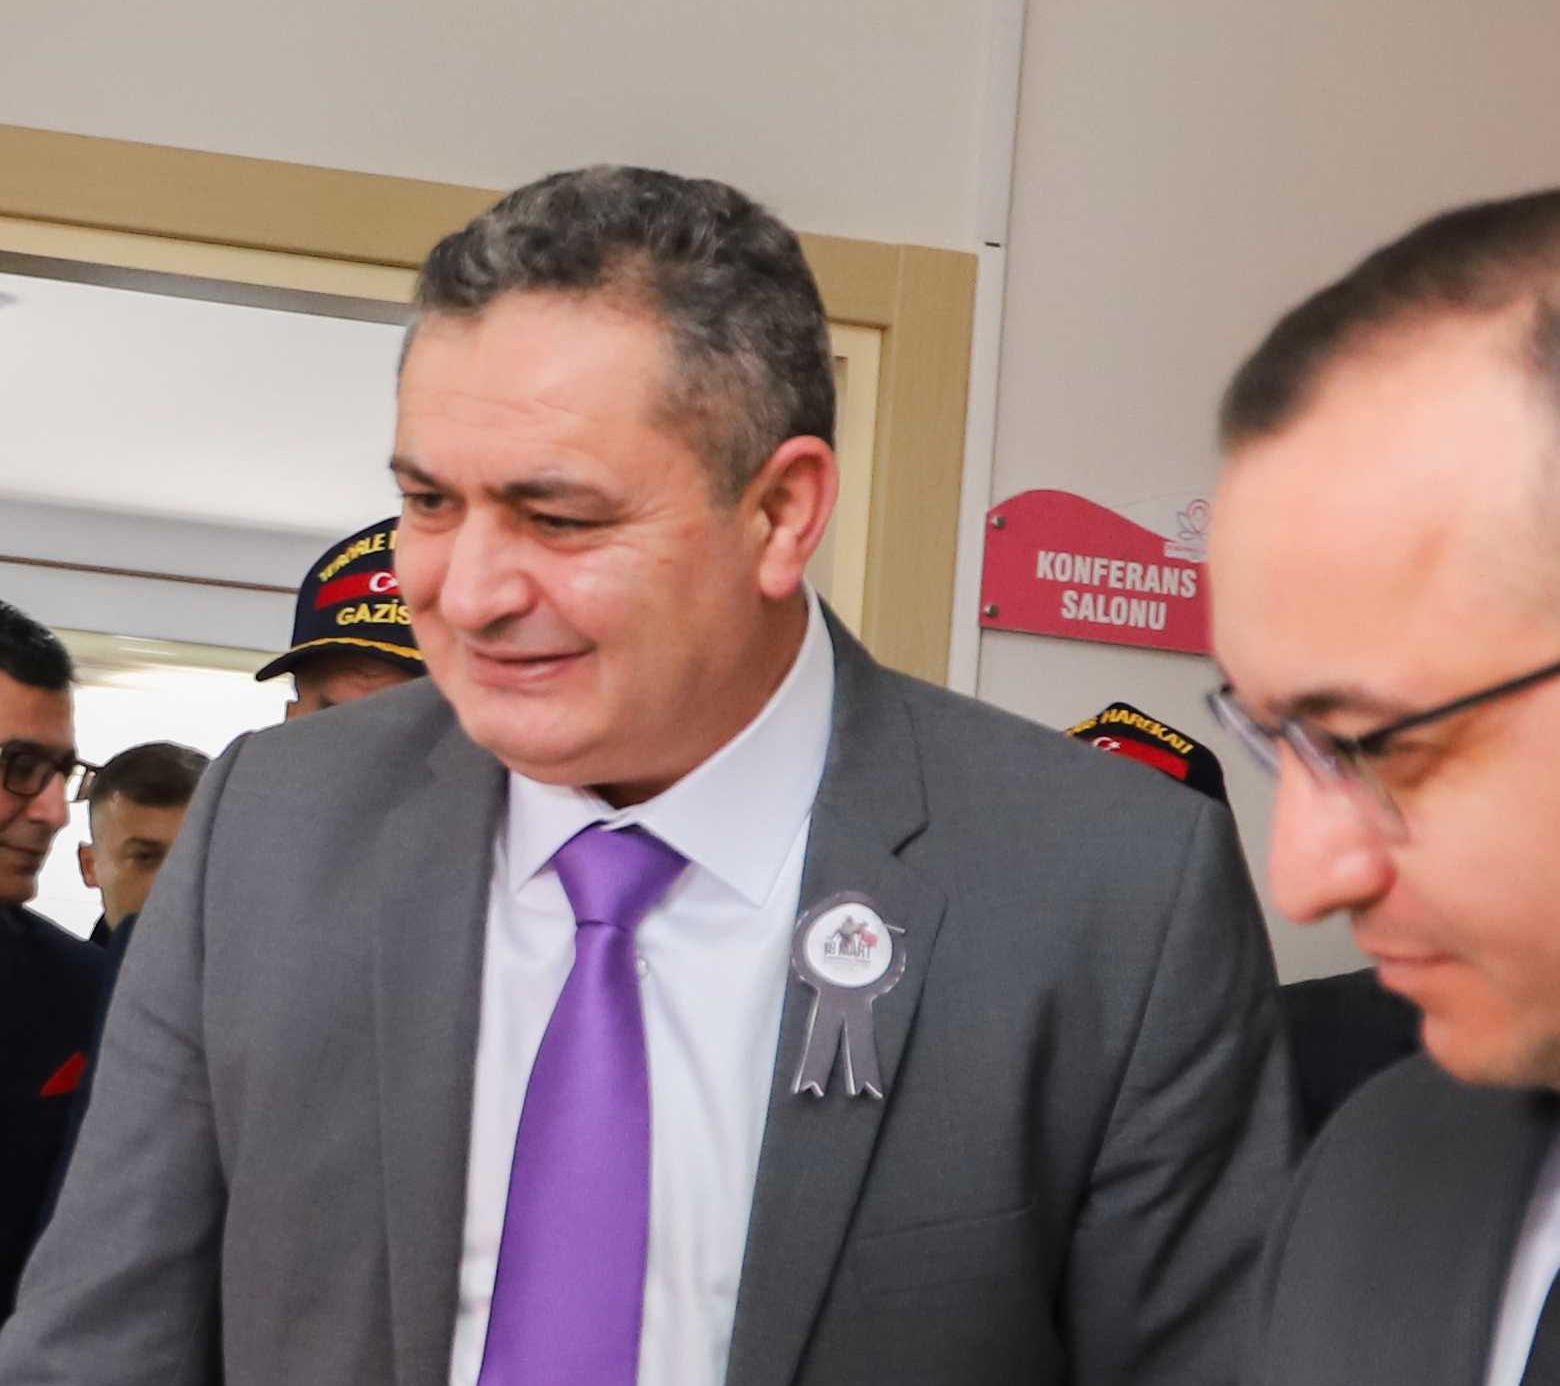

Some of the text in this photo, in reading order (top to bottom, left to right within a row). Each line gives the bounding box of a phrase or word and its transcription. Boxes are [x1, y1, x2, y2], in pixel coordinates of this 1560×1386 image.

[1036, 550, 1198, 599] KONFERANS
[336, 599, 413, 626] GAZİS
[1061, 590, 1168, 631] SALONU
